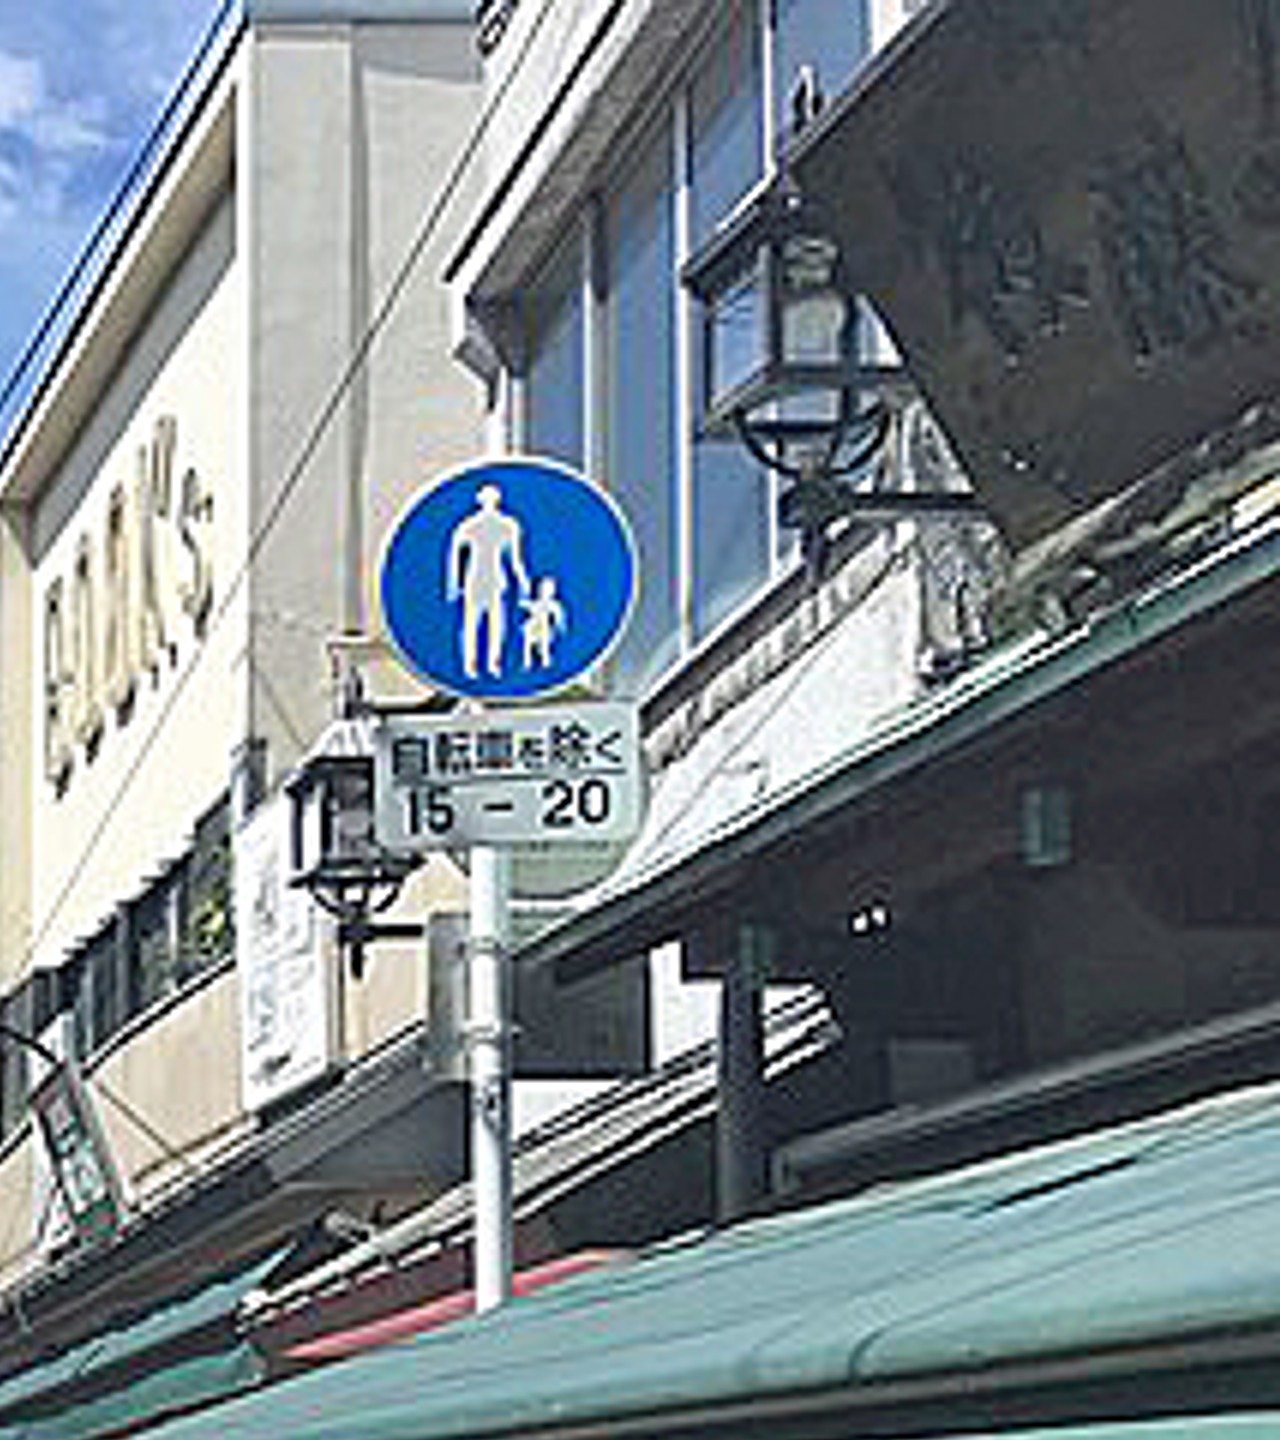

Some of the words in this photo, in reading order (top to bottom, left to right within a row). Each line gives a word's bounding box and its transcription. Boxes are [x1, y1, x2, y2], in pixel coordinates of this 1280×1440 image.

[392, 721, 623, 778] 自転車を除く
